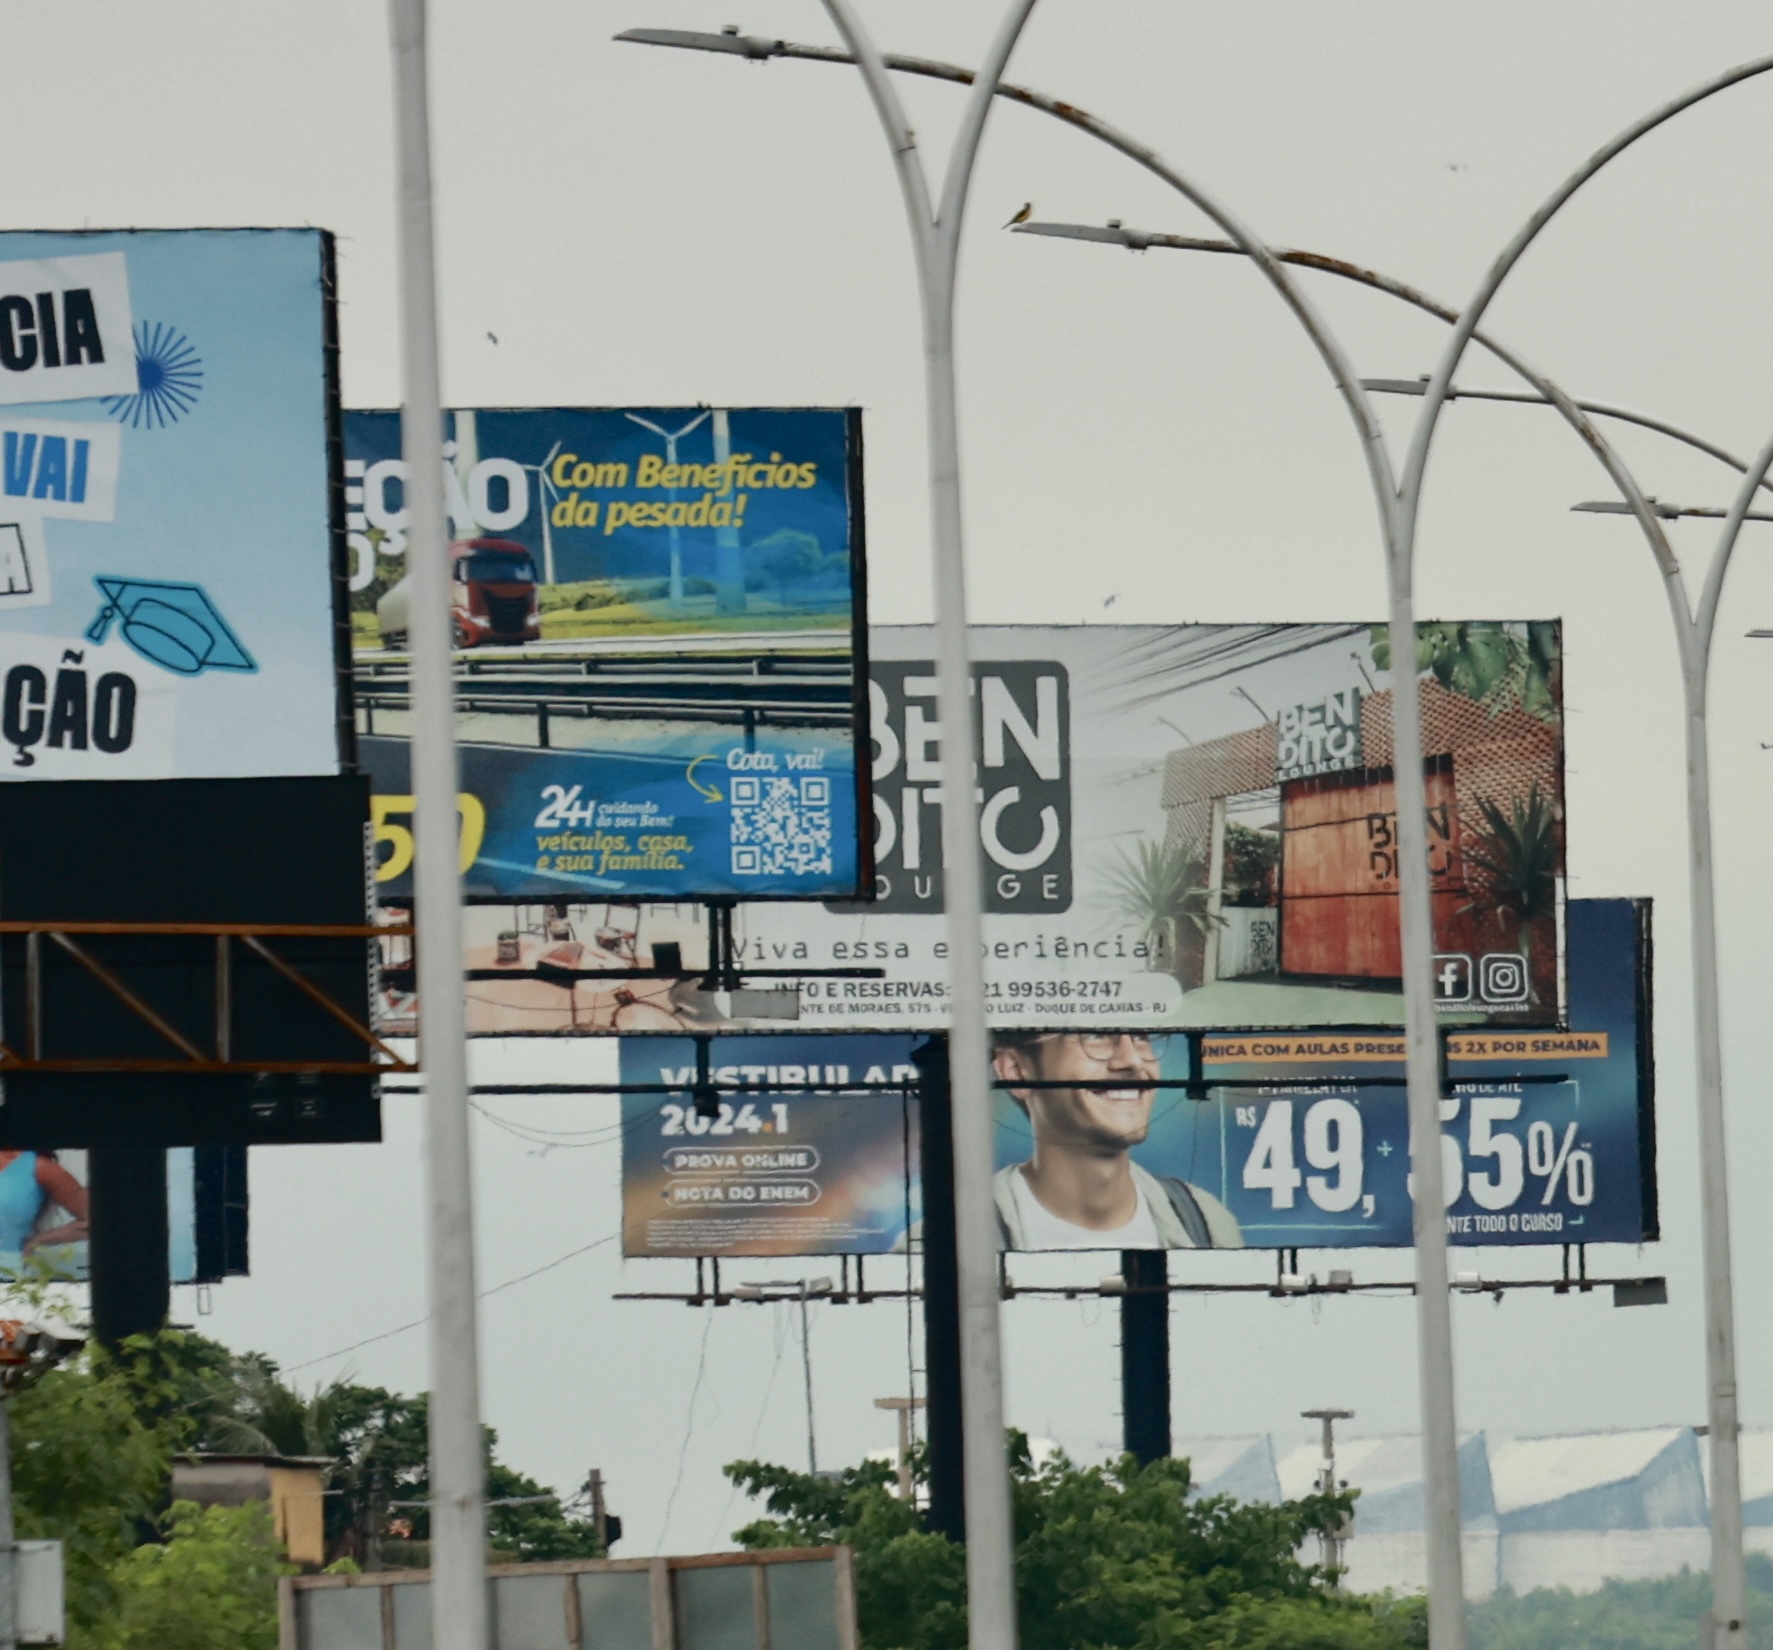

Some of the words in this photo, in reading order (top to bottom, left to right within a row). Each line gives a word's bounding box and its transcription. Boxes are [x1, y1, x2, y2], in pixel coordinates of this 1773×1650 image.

[0, 288, 105, 371] CIA
[4, 431, 90, 504] VAI
[553, 453, 628, 488] Com
[636, 452, 817, 496] Benefícios
[551, 492, 598, 527] da
[604, 492, 748, 536] pesada!
[3, 649, 136, 768] ÇÃO
[536, 830, 632, 852] veículos,
[638, 834, 694, 853] casa,
[537, 855, 550, 869] e
[555, 855, 595, 870] sua
[731, 937, 808, 960] Viva
[832, 940, 910, 960] essa
[932, 934, 1164, 960] eeriência!
[826, 982, 838, 998] E
[1007, 980, 1123, 999] 99536-2747
[1252, 1044, 1289, 1056] COM
[1295, 1043, 1350, 1055] AULAS
[1466, 1041, 1488, 1054] 2X
[1493, 1041, 1527, 1053] POR
[1531, 1039, 1600, 1052] SEMANA
[675, 1155, 738, 1168] PROVA
[1475, 1216, 1506, 1232] TODO
[1521, 1213, 1563, 1231] CURSO
